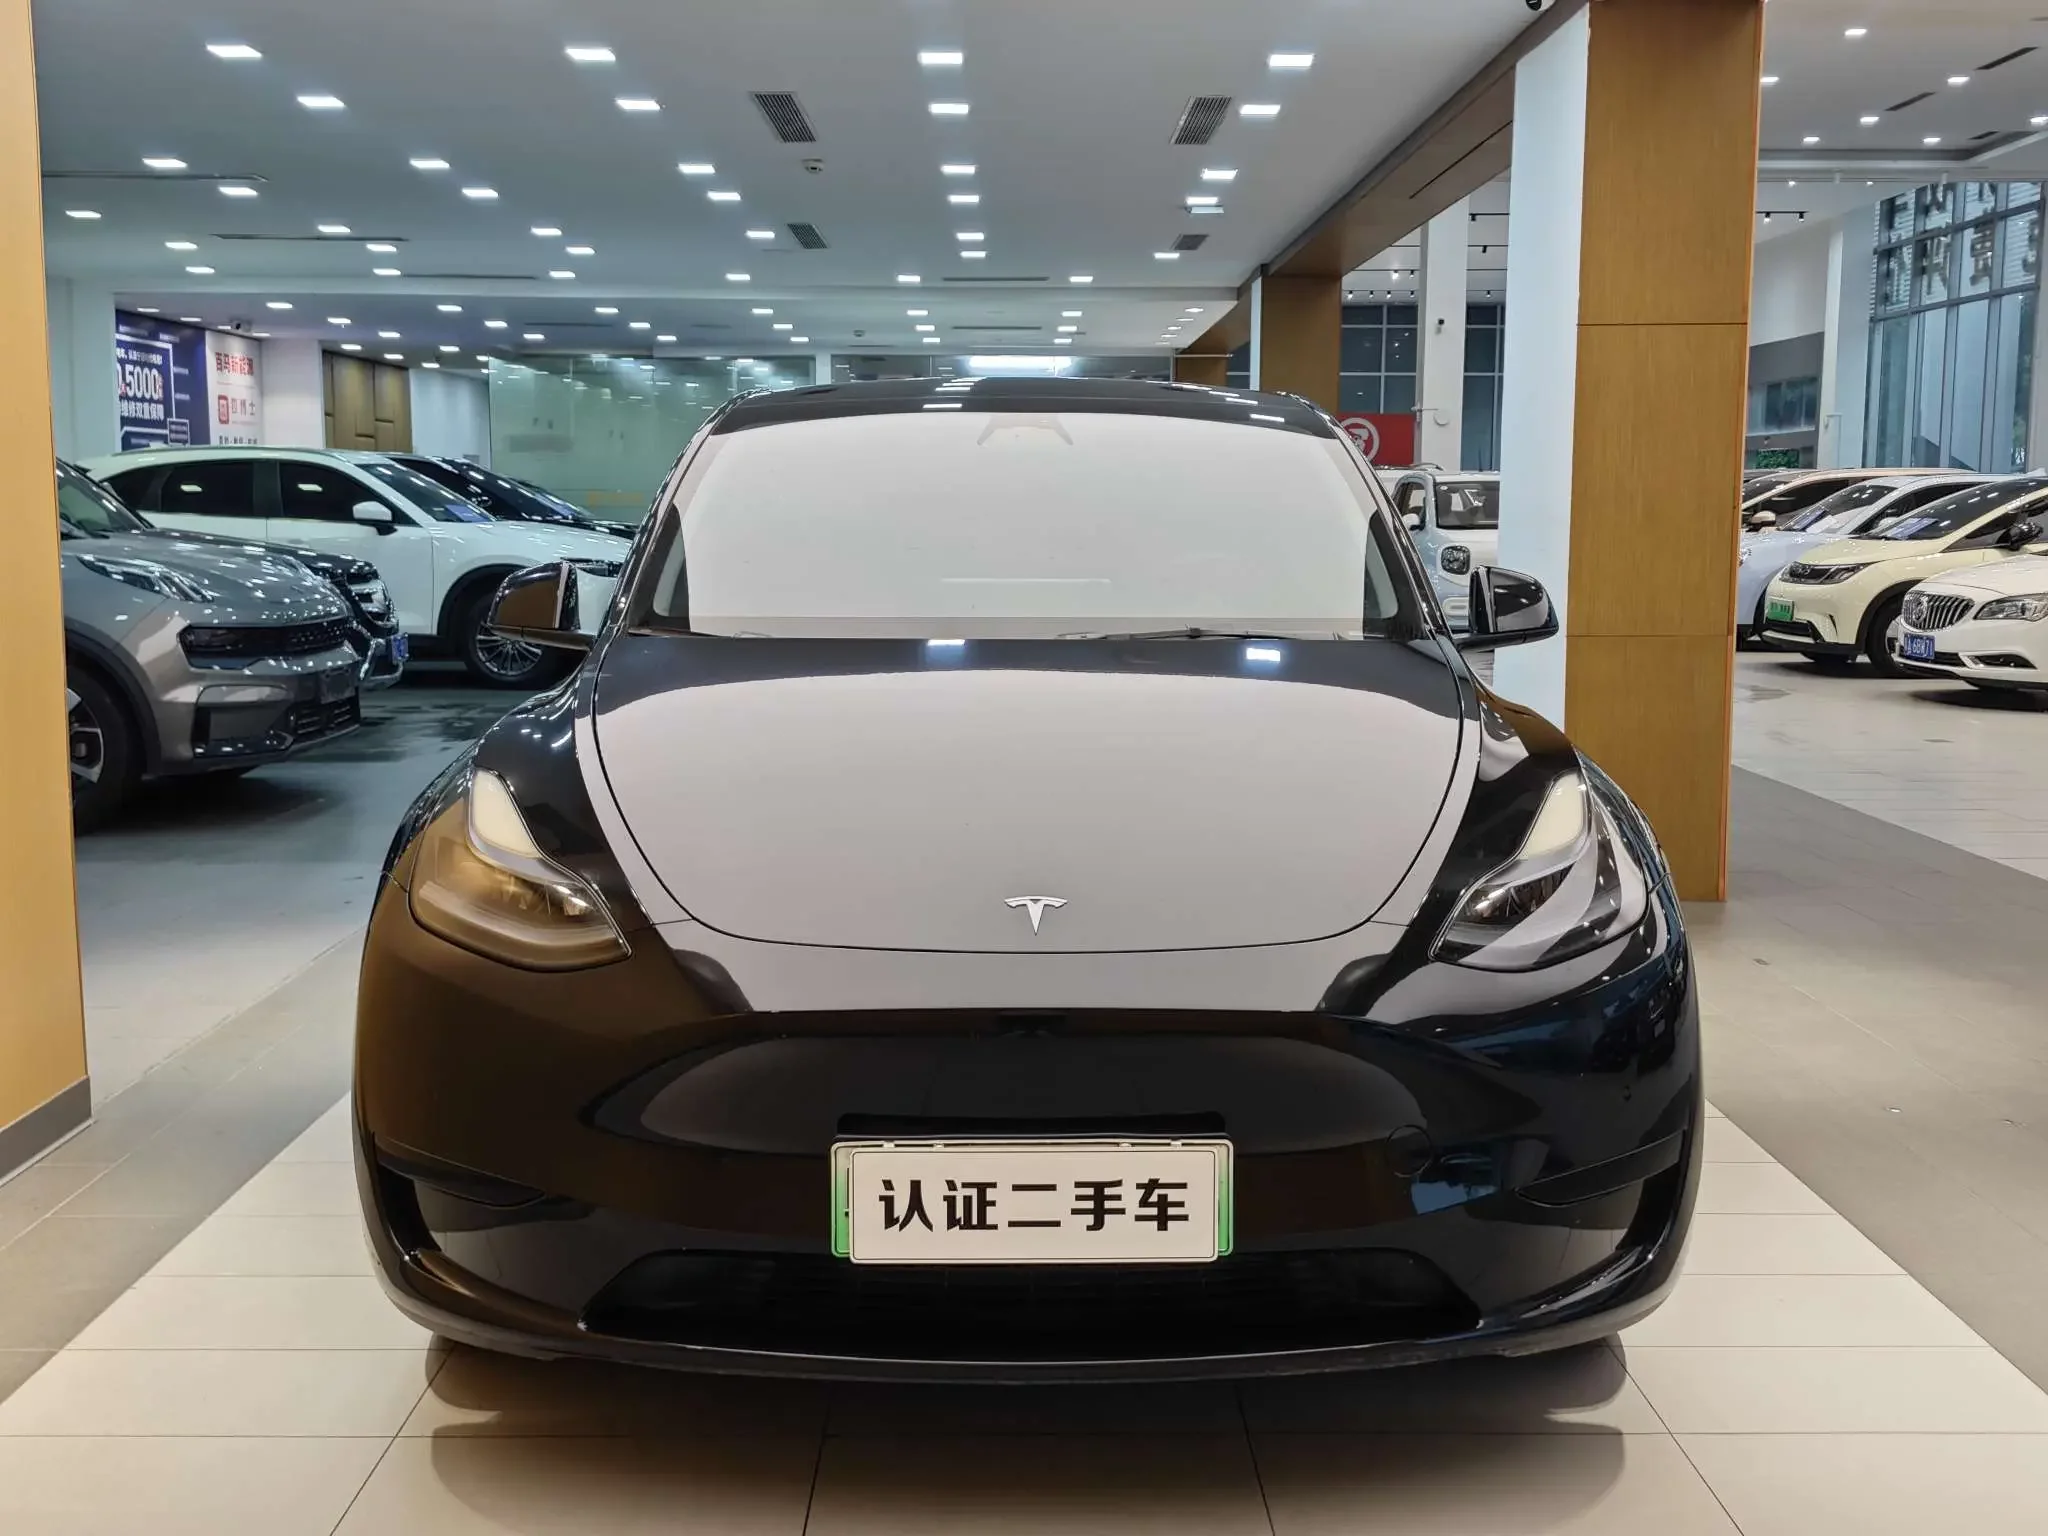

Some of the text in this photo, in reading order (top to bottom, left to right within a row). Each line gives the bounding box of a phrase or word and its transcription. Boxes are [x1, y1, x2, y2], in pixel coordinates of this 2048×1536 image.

[879, 1178, 1189, 1232] 认证二手车
